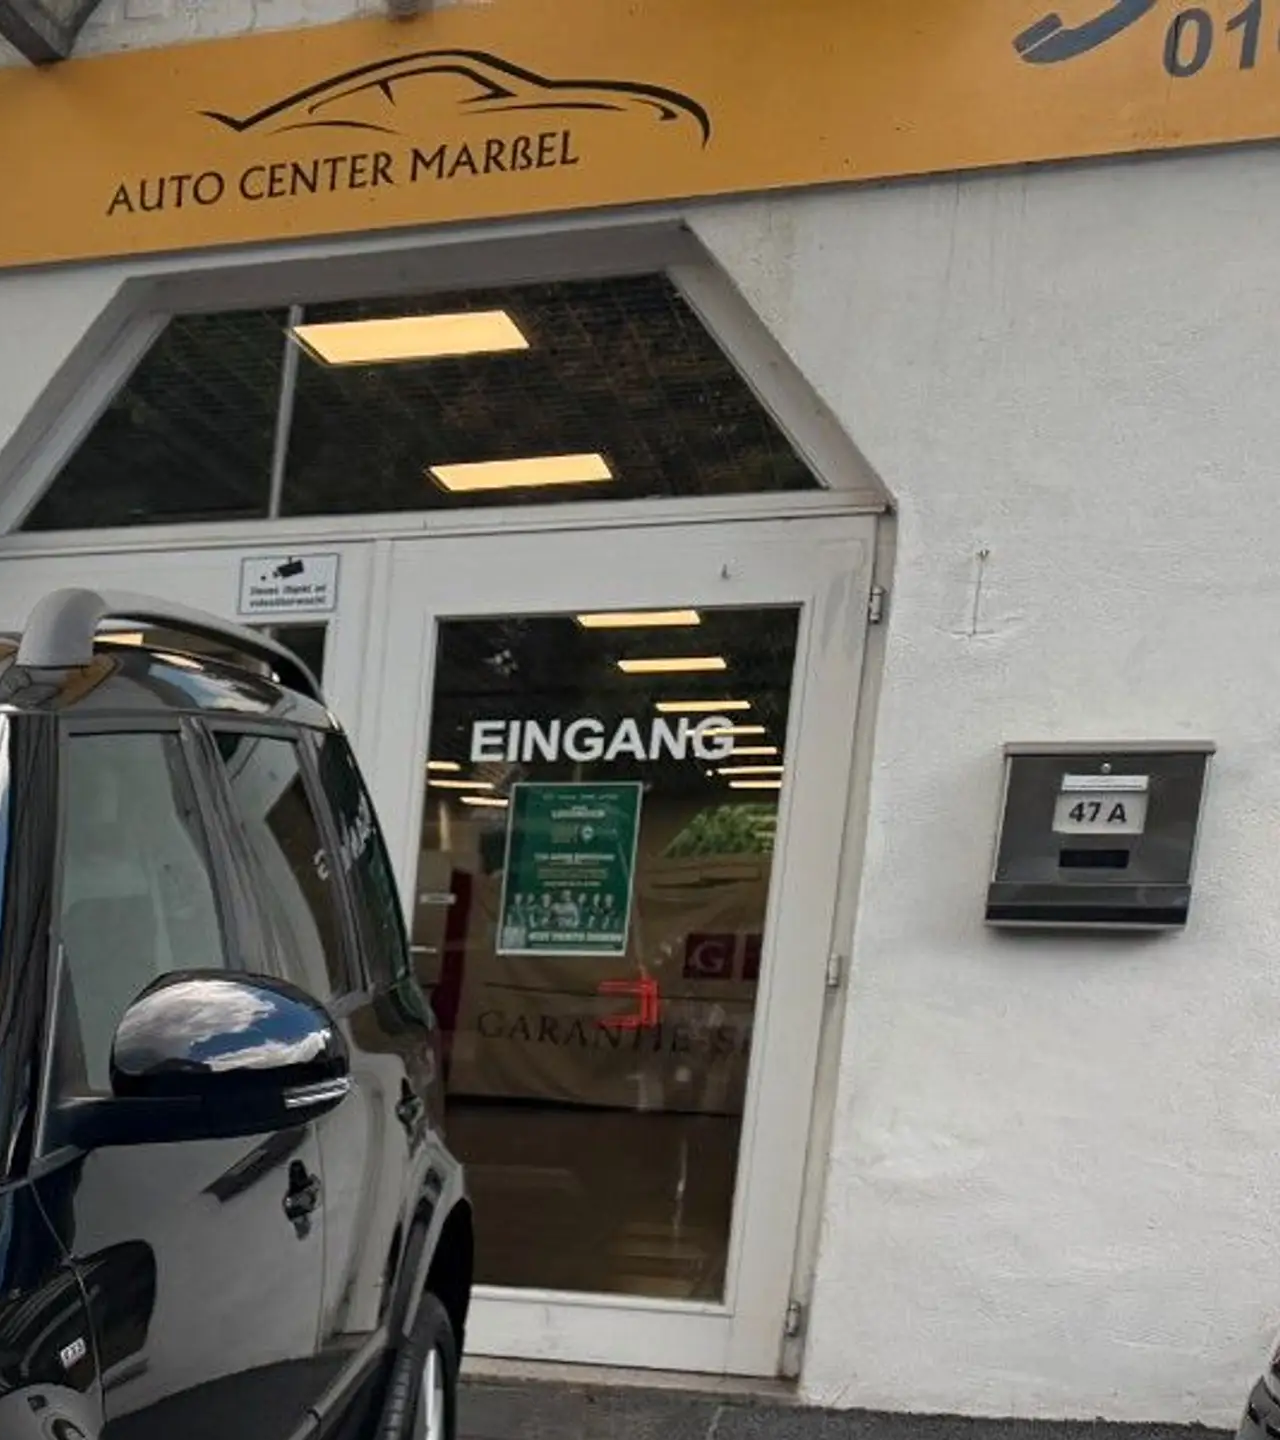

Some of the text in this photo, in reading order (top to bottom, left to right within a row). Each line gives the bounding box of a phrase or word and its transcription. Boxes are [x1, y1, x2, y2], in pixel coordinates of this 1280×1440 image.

[1162, 0, 1280, 78] 01
[105, 129, 580, 216] AUTO CENTER MARßEL
[469, 715, 735, 762] EINGANG
[1068, 801, 1128, 824] 47 A
